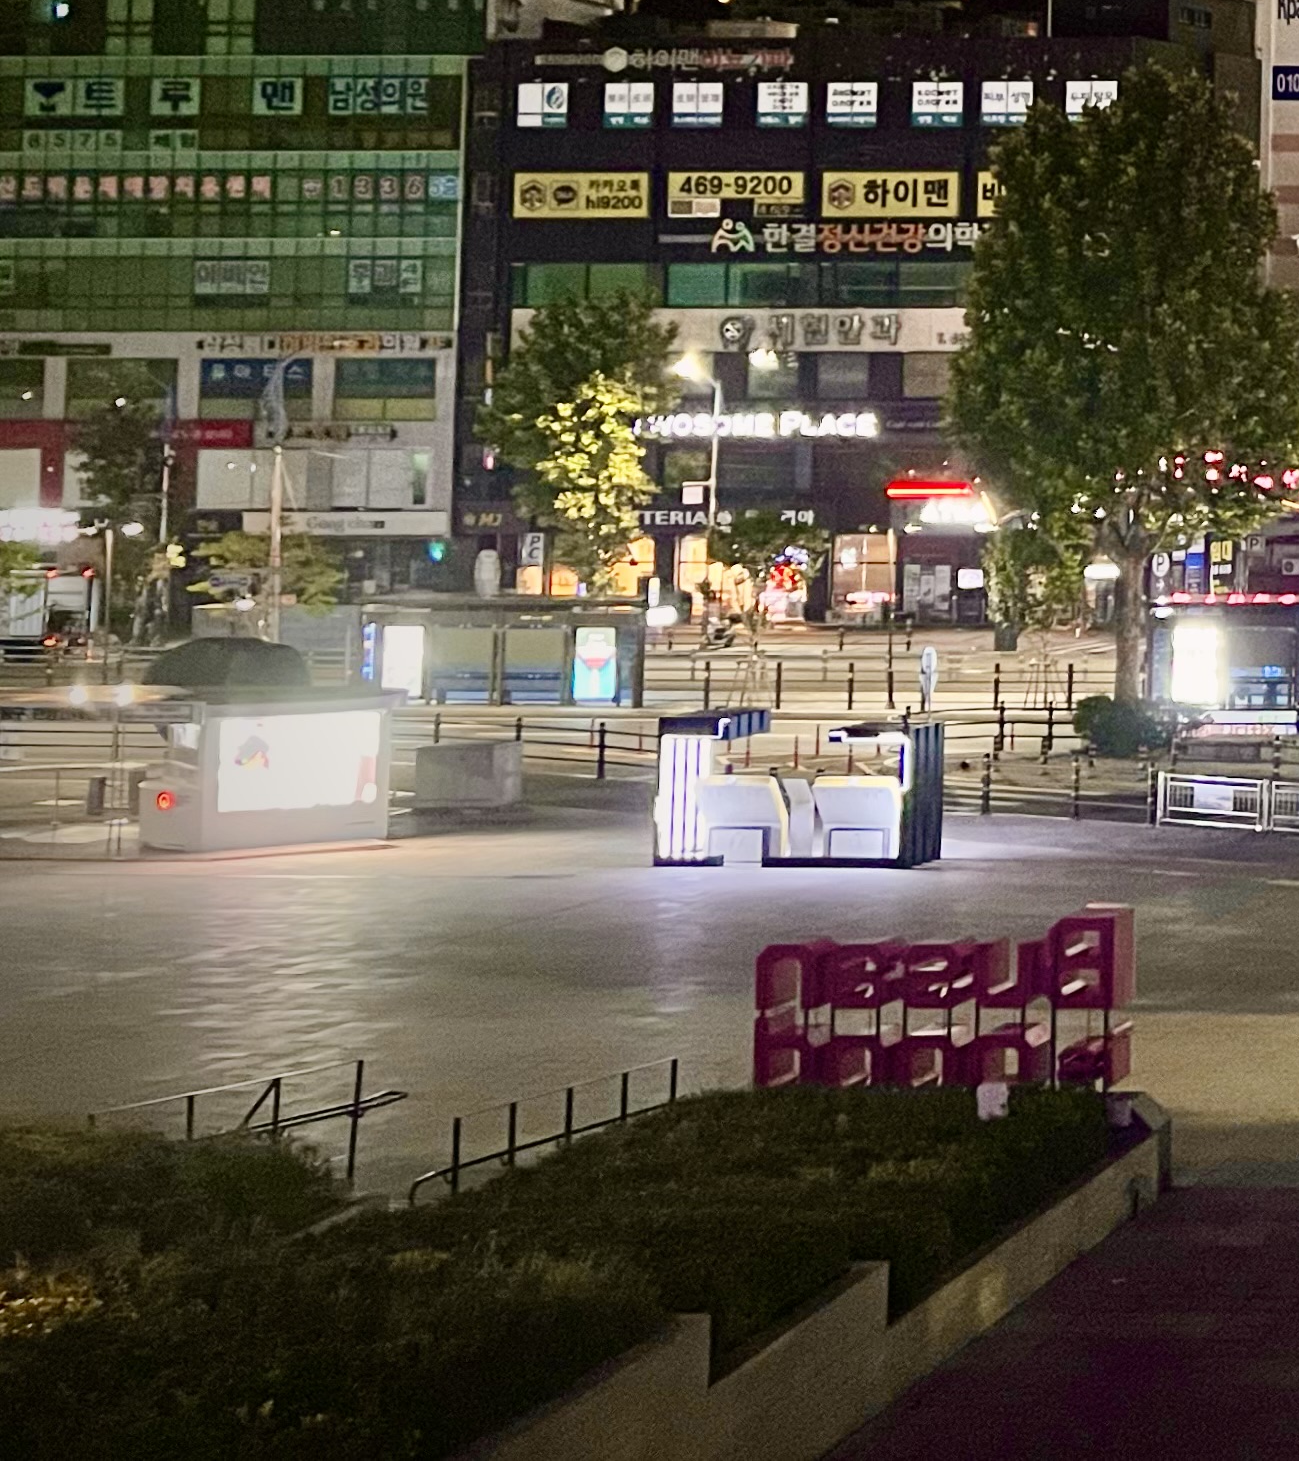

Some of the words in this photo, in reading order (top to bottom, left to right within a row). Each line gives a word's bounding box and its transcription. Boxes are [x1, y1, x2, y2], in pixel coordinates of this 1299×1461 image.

[331, 79, 428, 114] 남성의원
[331, 176, 425, 198] 1336
[588, 179, 640, 194] 카카오톡
[679, 176, 792, 195] 469-9200
[863, 178, 949, 208] 하이맨
[763, 222, 991, 254] 한결정신건강의학
[779, 410, 879, 438] PLACE
[528, 535, 541, 560] PC
